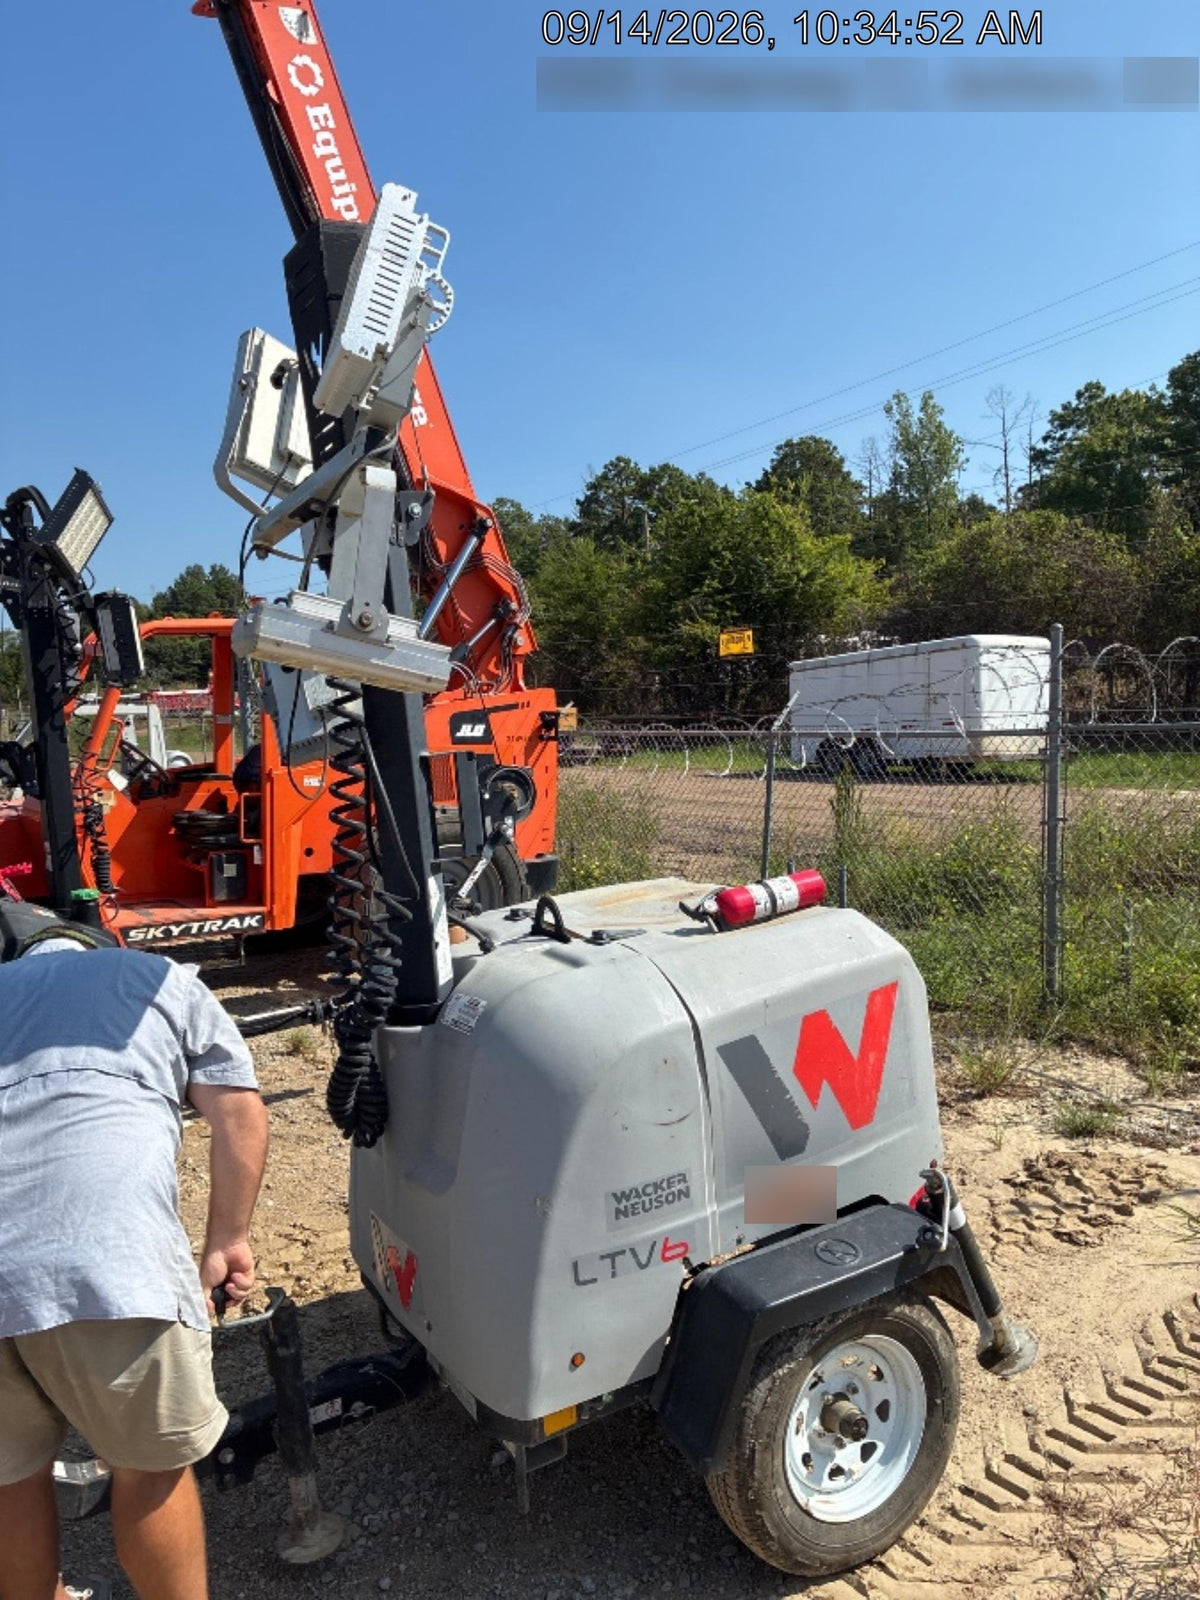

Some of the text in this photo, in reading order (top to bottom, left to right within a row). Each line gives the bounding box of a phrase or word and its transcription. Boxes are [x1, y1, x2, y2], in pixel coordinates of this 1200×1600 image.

[455, 723, 487, 737] JLG
[127, 914, 262, 942] SKYTRAK
[611, 1172, 688, 1205] WACKER
[614, 1185, 691, 1221] NEUSON
[571, 1236, 690, 1287] LTV6
